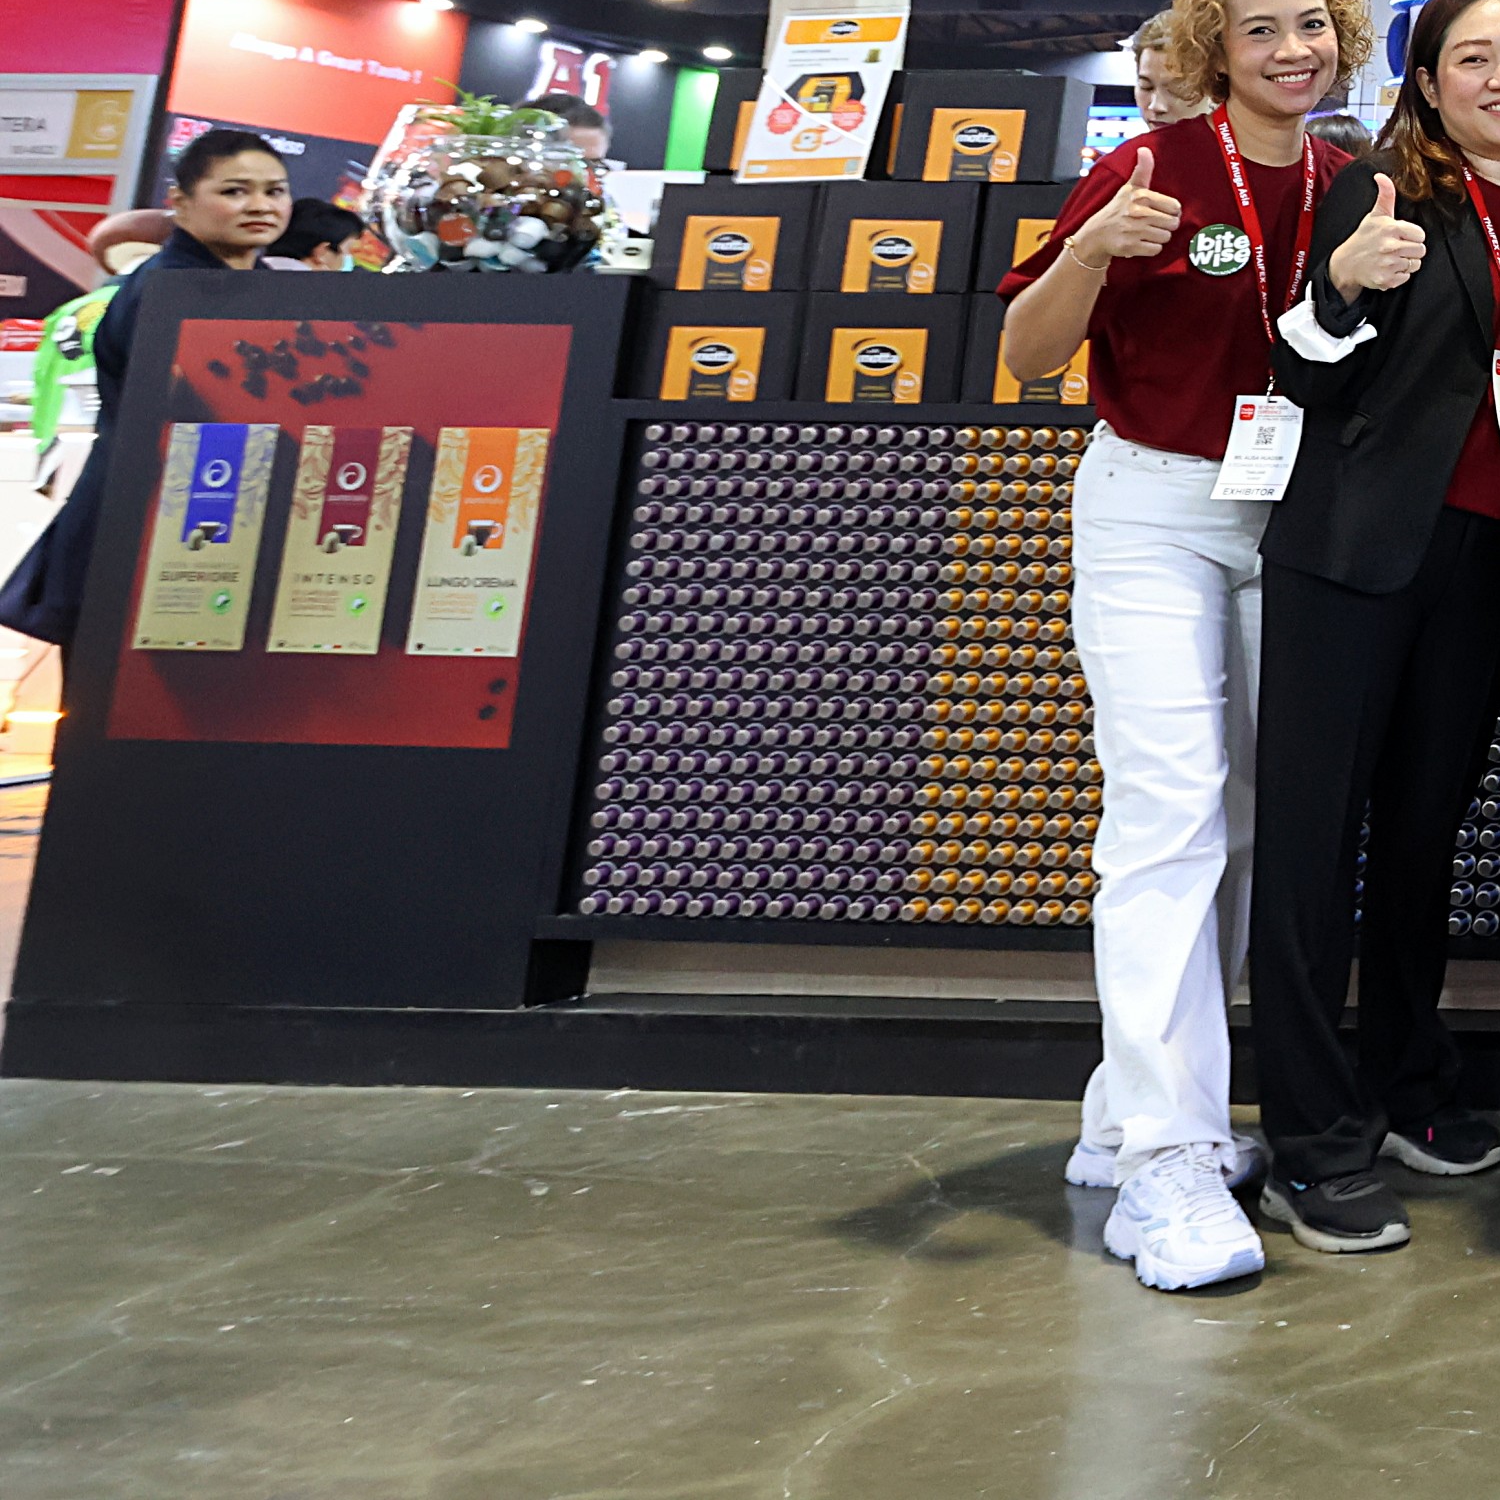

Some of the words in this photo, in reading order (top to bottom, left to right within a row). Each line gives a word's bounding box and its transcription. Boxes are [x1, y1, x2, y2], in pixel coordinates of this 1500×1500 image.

[1217, 122, 1237, 156] THAIFEX
[1229, 160, 1243, 188] Anuga
[1238, 188, 1250, 207] Asia
[1303, 178, 1314, 212] THAIFEX
[1196, 231, 1251, 253] bite
[1482, 216, 1500, 250] THAIFEX
[1189, 247, 1251, 267] wise
[1254, 245, 1268, 283] THAIFEX
[1223, 488, 1275, 496] EXHIBITOR
[293, 574, 376, 585] INTENSO
